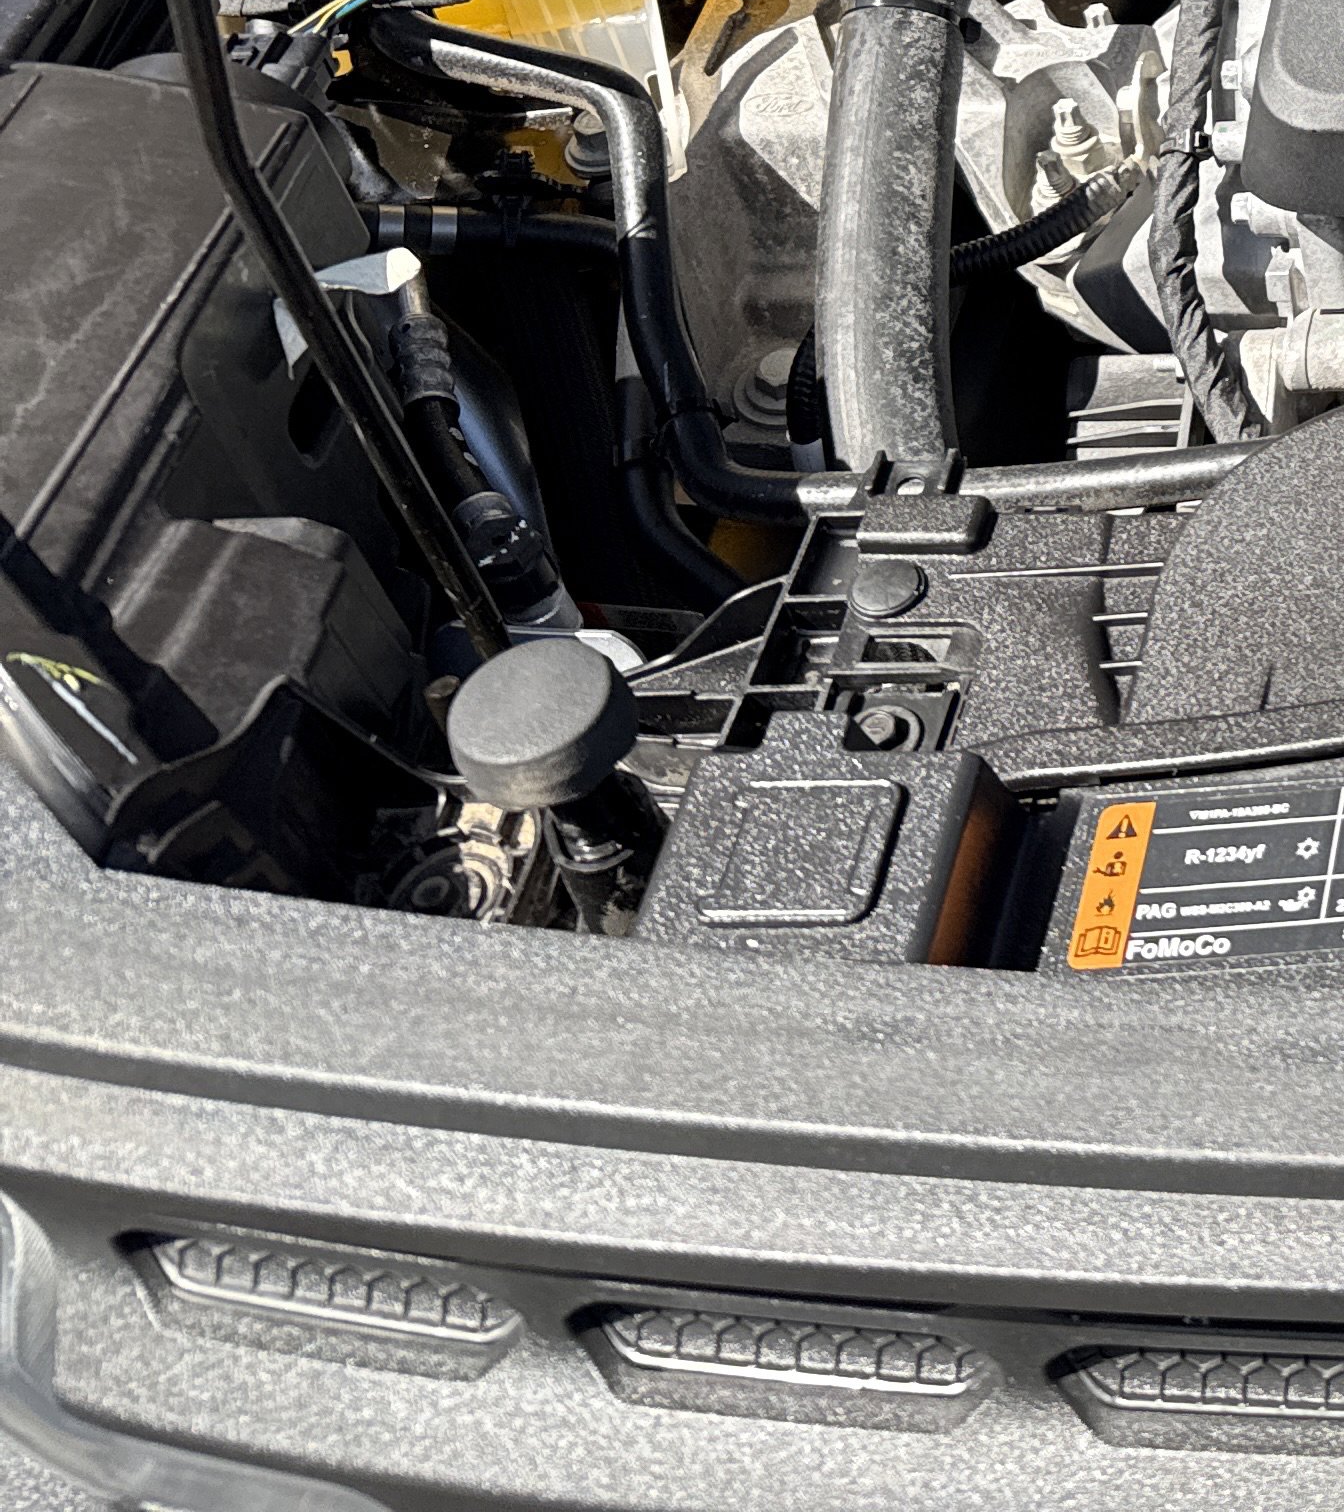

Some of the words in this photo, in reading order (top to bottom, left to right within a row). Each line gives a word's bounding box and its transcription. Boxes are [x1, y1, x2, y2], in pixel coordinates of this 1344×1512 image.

[1184, 843, 1267, 865] R-1234yf
[1135, 902, 1177, 920] PAG
[1125, 934, 1232, 961] FoMoCo
